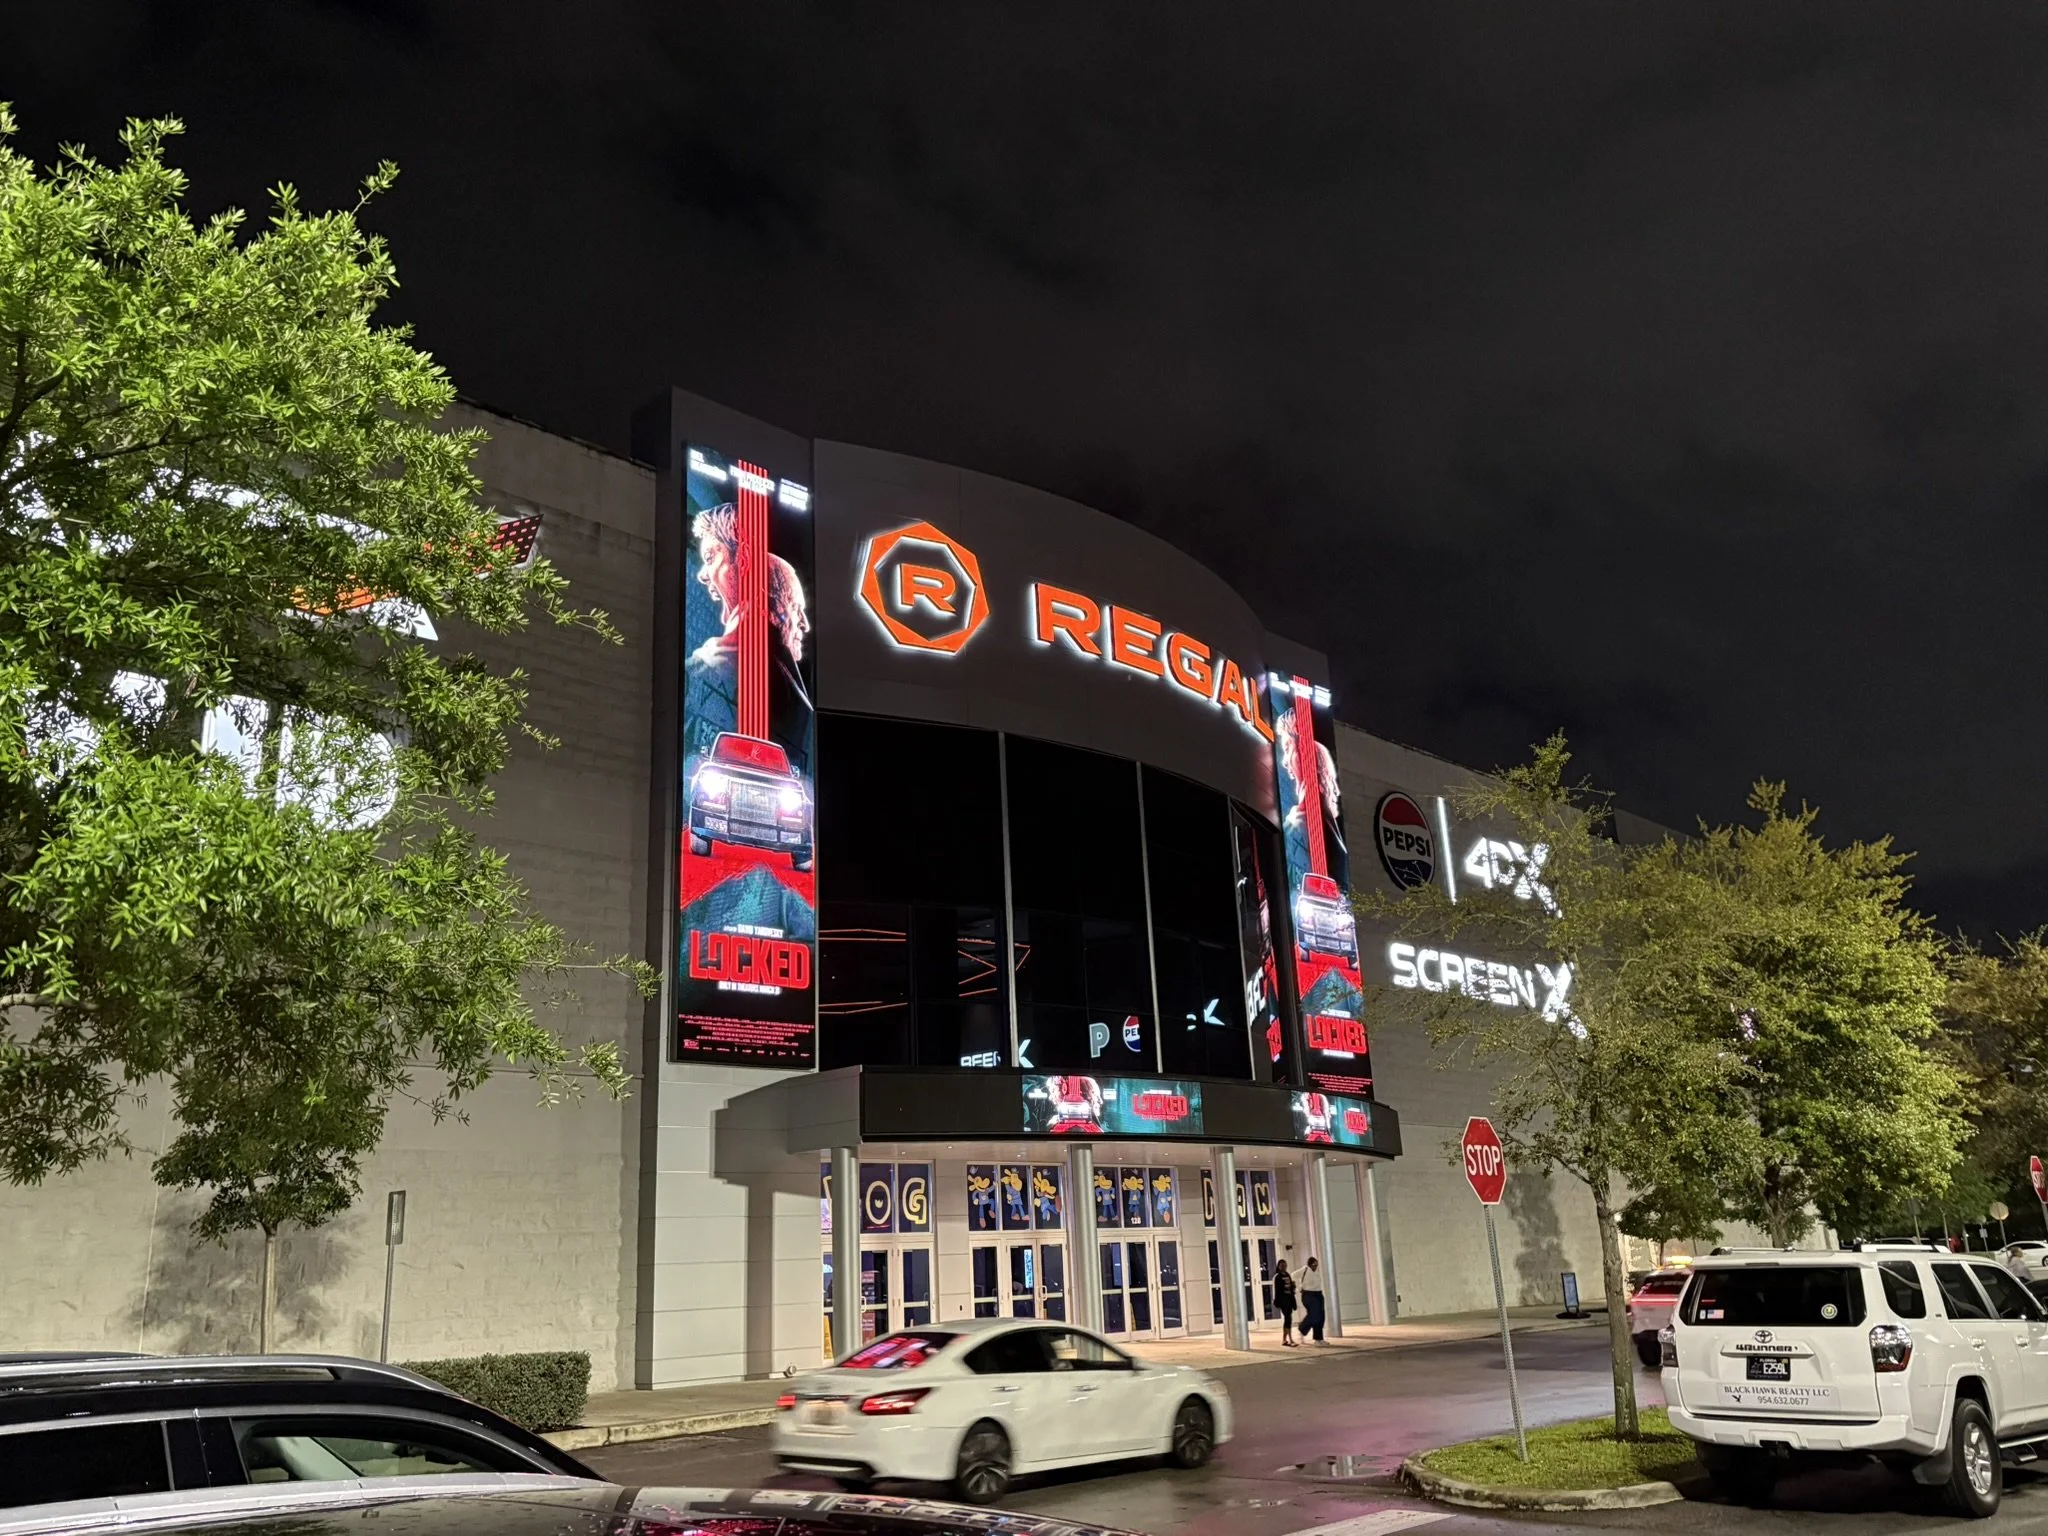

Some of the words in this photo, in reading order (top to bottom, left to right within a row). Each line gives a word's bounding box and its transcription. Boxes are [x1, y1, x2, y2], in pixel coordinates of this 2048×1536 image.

[899, 563, 956, 615] R
[1035, 582, 1274, 744] REGAL
[1382, 826, 1431, 858] PEPSI
[689, 929, 811, 990] LOCKED
[1305, 1013, 1367, 1054] LOCKED
[1132, 1093, 1189, 1116] LOCKED
[1466, 1144, 1501, 1176] STOP
[1724, 1385, 1751, 1394] BLACK
[1752, 1386, 1778, 1395] HAWK
[1778, 1387, 1812, 1397] REALTY
[1812, 1388, 1831, 1397] LLC
